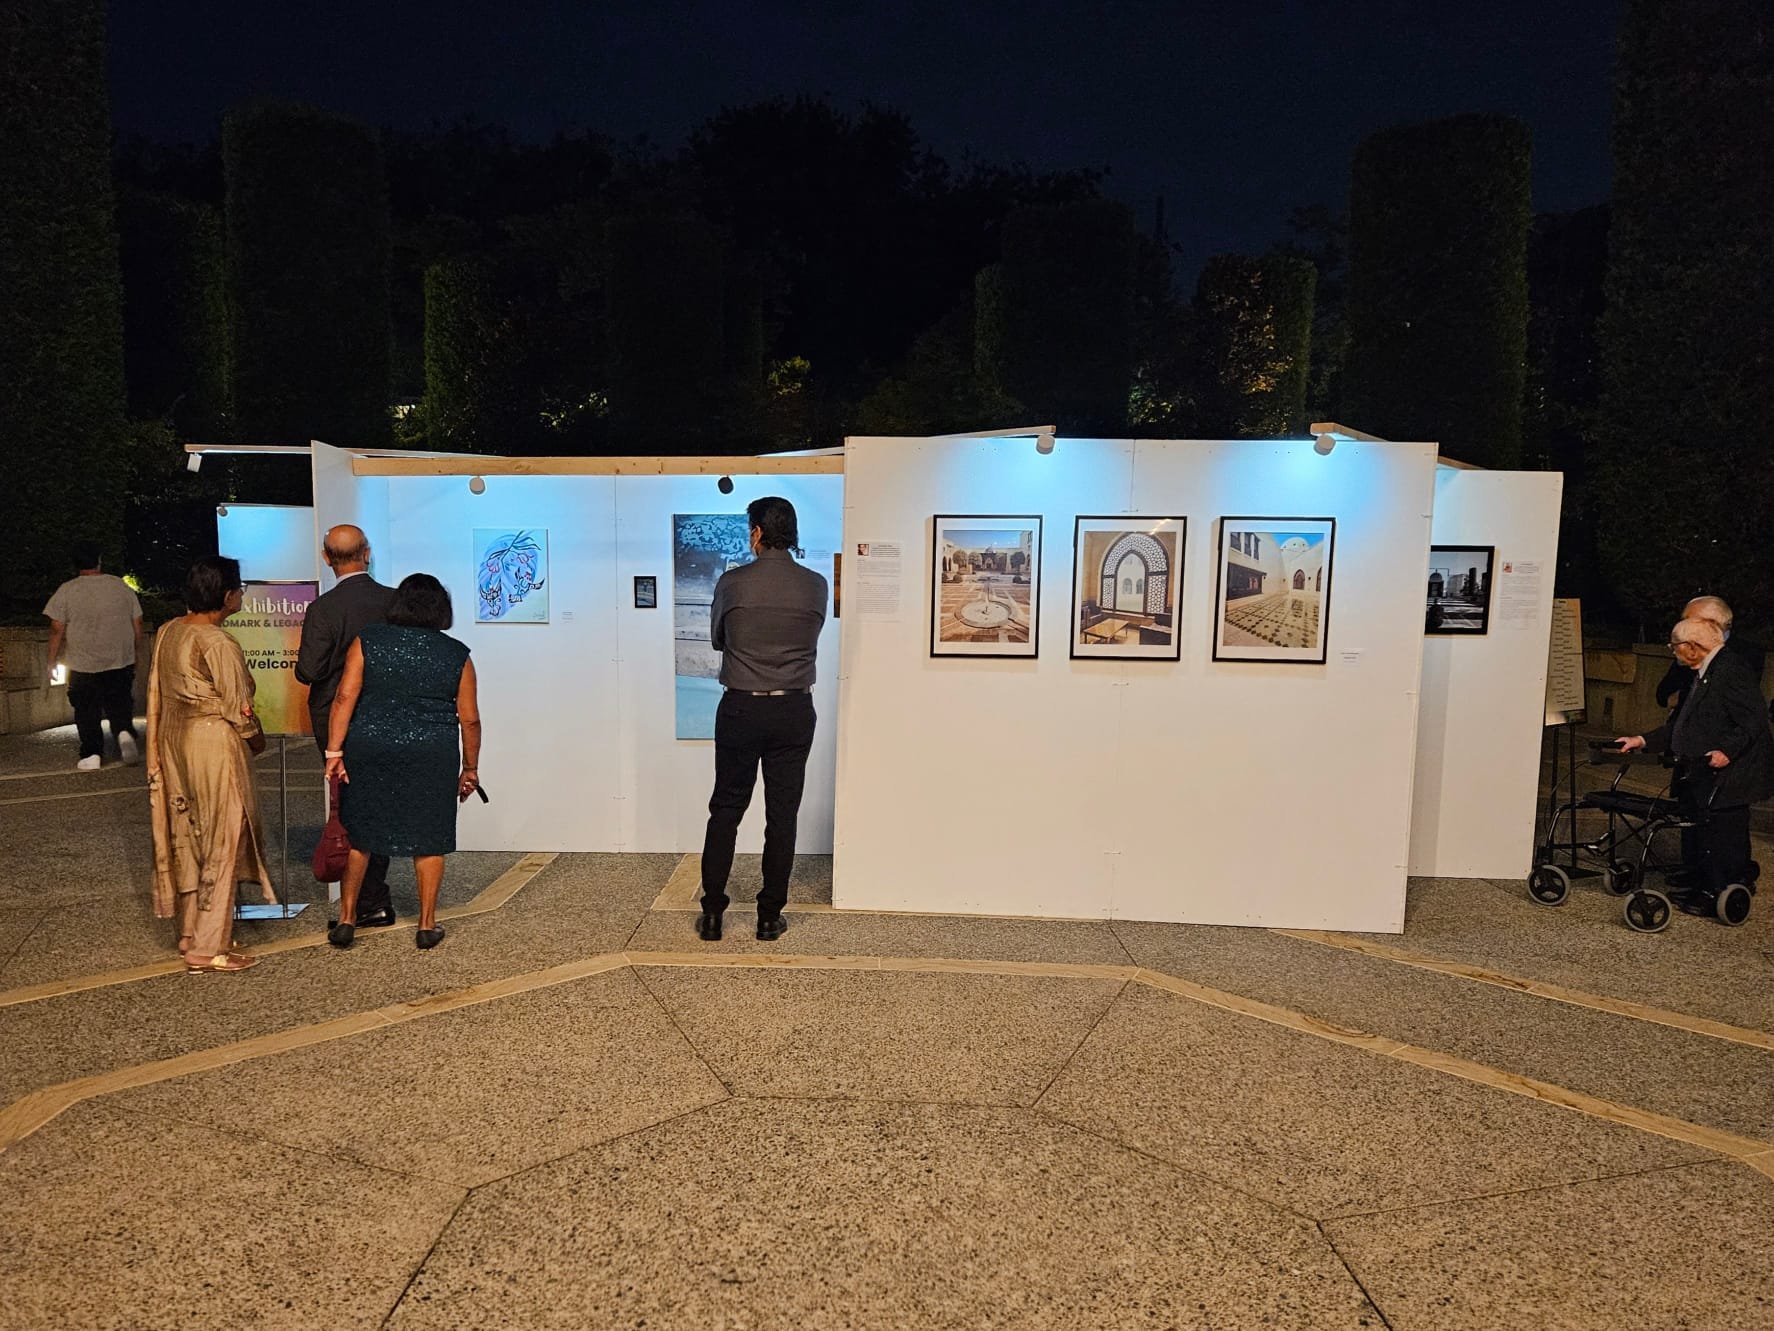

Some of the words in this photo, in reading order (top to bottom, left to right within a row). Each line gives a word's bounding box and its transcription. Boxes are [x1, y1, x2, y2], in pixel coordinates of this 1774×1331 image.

[243, 597, 312, 615] xhibition
[220, 619, 260, 627] DMARK
[263, 619, 271, 627] &
[274, 619, 304, 627] LEGAC
